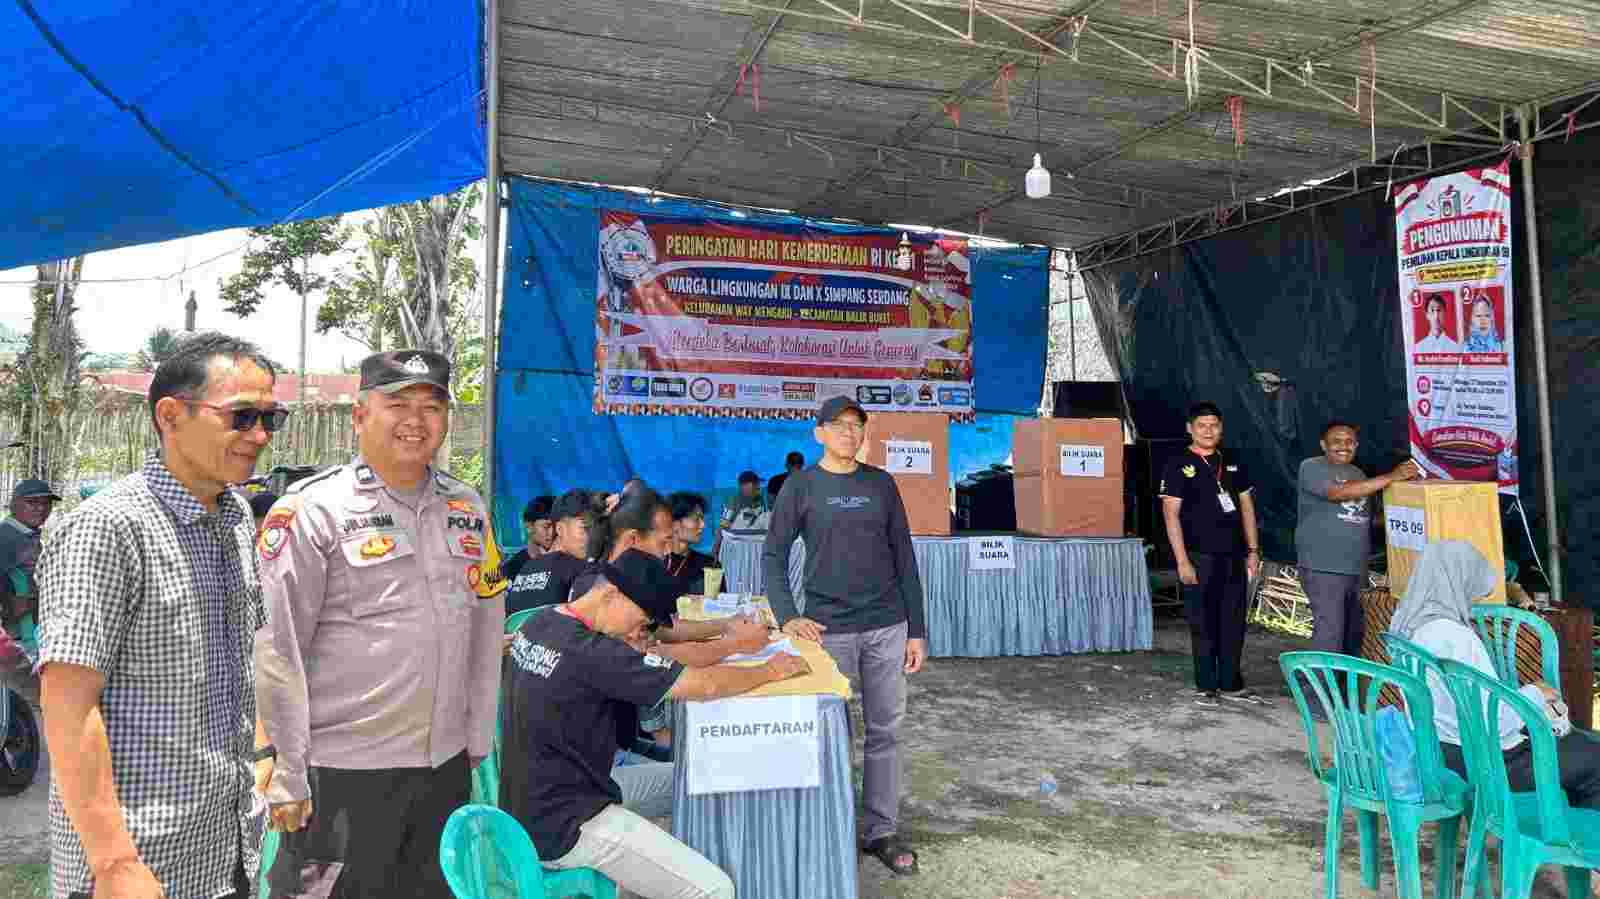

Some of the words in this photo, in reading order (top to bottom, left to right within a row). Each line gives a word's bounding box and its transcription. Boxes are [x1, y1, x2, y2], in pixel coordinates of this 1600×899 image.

[1408, 217, 1501, 250] PENGUMUMAN
[665, 235, 746, 258] PERINGATAN
[750, 238, 779, 260] HARI
[782, 240, 867, 267] KEMERDEKAAN
[871, 247, 882, 267] RI
[1436, 248, 1461, 262] KEPALA
[665, 275, 708, 296] WARGA
[710, 278, 778, 300] LINGKUNGAN
[793, 284, 814, 301] DAN
[815, 286, 823, 302] X
[824, 286, 866, 304] SIMPANG
[867, 289, 910, 306] SERDANG
[684, 301, 734, 314] KELURAHAN
[736, 304, 753, 317] WAY
[800, 308, 844, 322] KECAMATAN
[1062, 449, 1079, 457] BILIK
[1080, 449, 1103, 458] SUARA
[905, 455, 913, 468] 2
[1080, 459, 1087, 472] 1
[1390, 519, 1408, 533] TPS
[1410, 521, 1424, 535] 09
[980, 540, 1004, 550] BILIK
[978, 551, 1009, 561] SUARA
[699, 720, 815, 738] PENDAFTARAN
